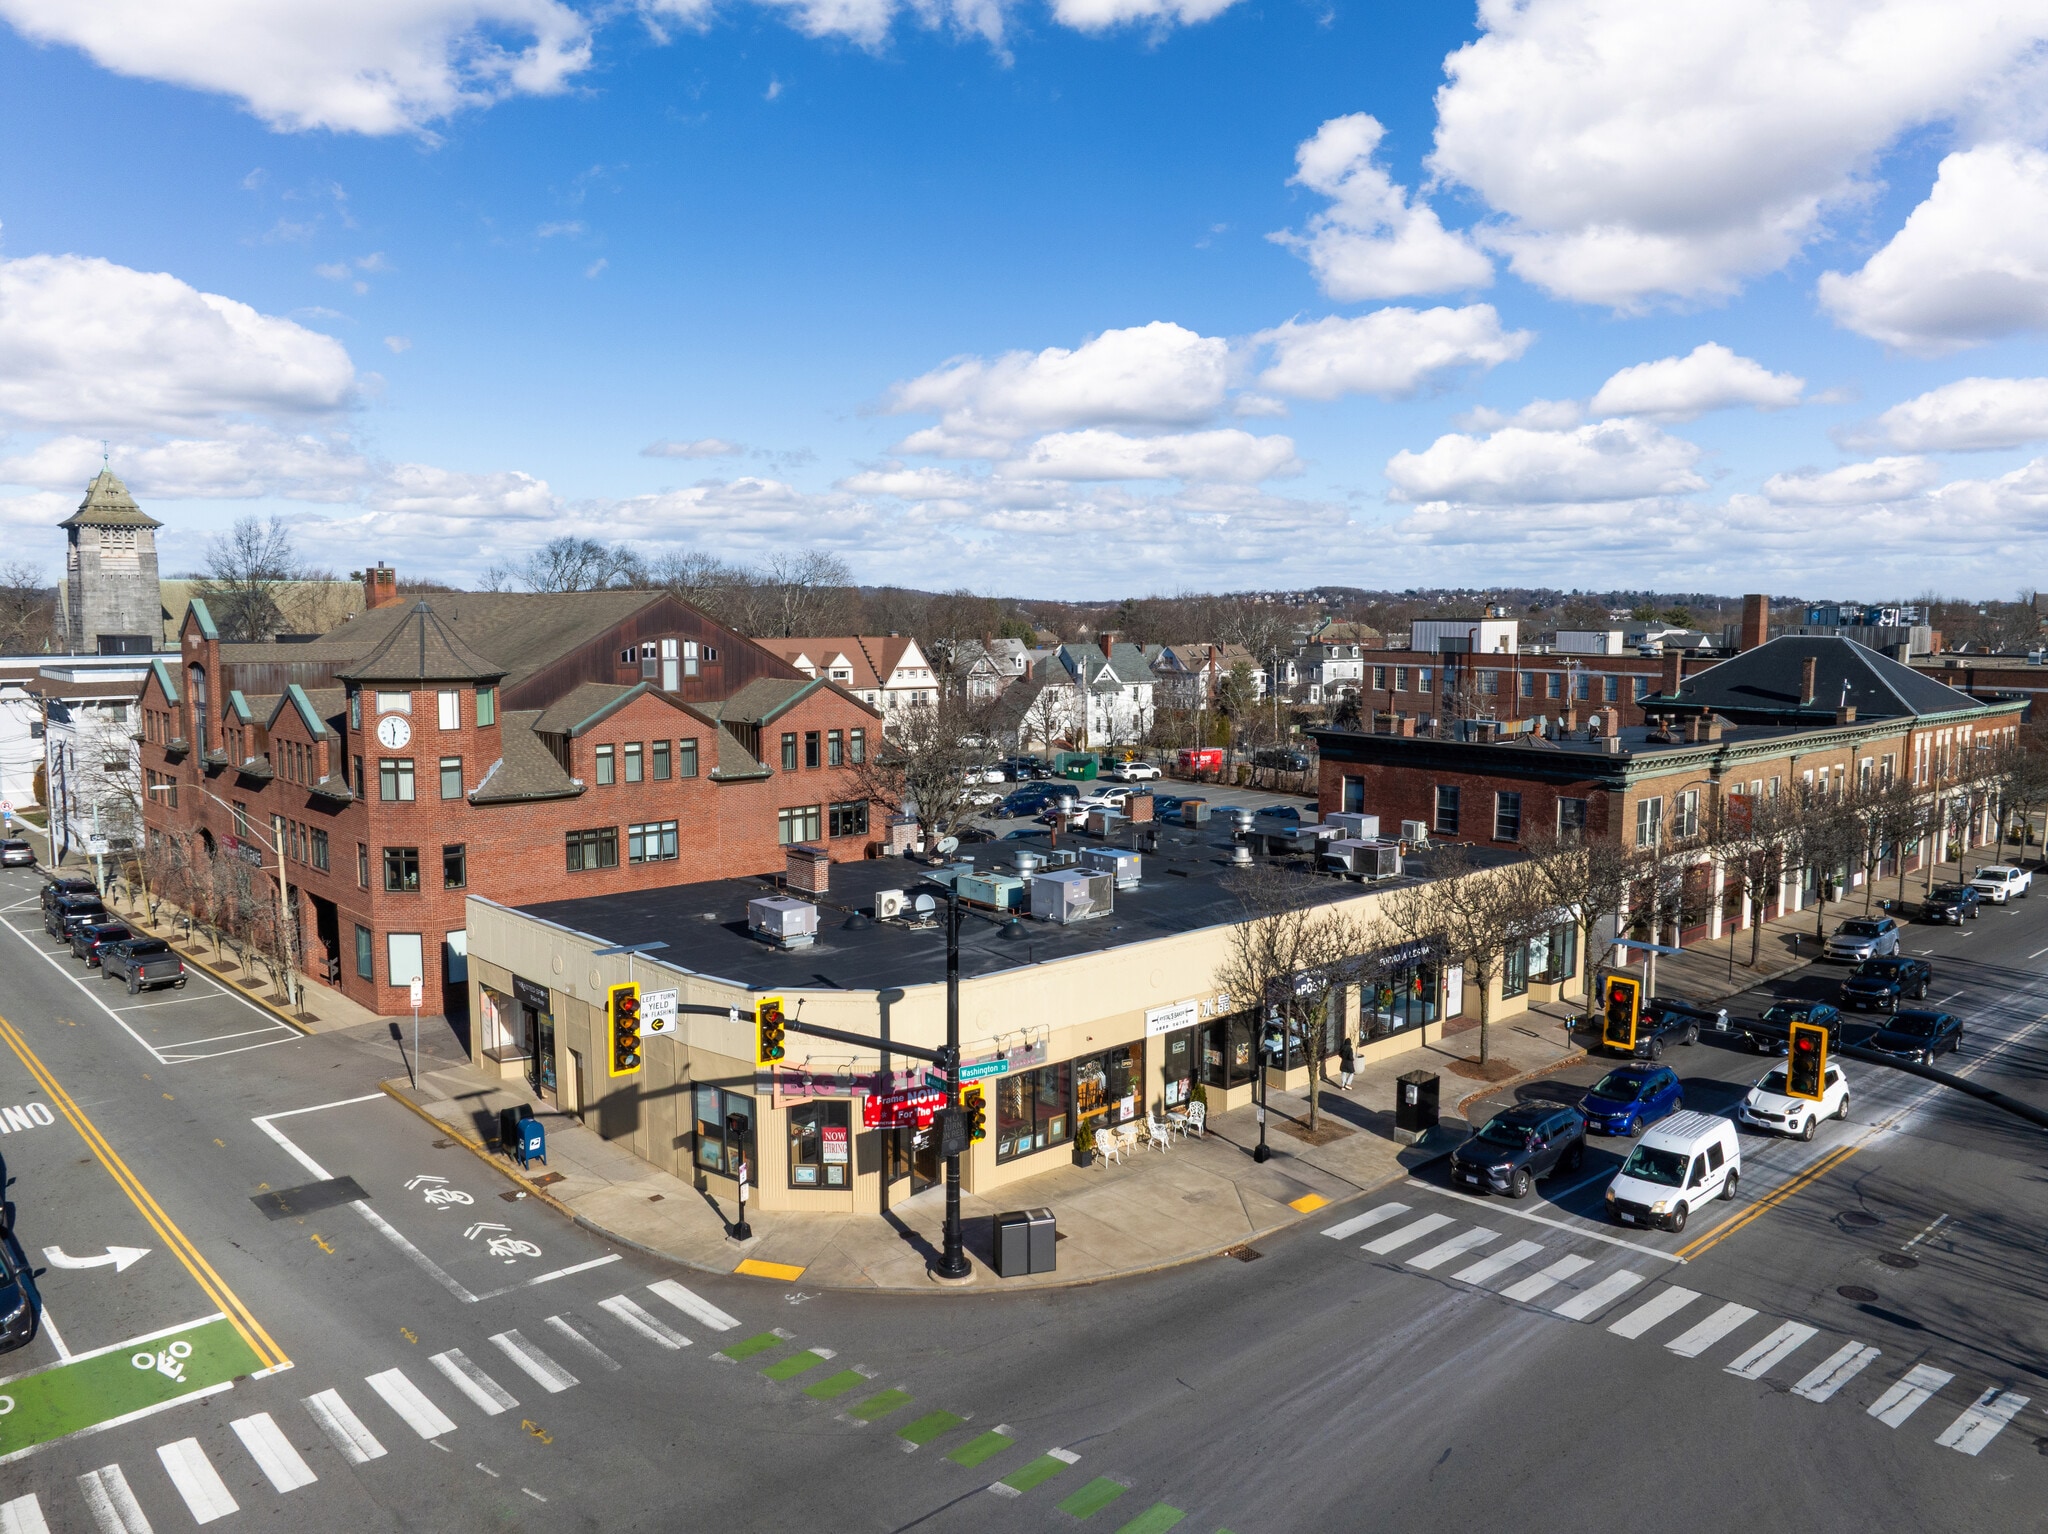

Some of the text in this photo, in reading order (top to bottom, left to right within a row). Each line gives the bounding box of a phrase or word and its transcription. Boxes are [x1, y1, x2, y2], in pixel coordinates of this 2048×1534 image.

[642, 992, 676, 1003] LEFT TURN
[648, 1000, 669, 1011] YIELD
[651, 1008, 675, 1018] FLASHING
[960, 1064, 999, 1078] Washington
[876, 1088, 940, 1106] Frame NOW
[898, 1109, 912, 1119] For
[915, 1106, 931, 1117] The
[945, 1113, 959, 1123] NO
[942, 1121, 962, 1131] TURN
[824, 1131, 846, 1141] NOW
[951, 1129, 965, 1138] RED
[823, 1142, 848, 1154] HIRING
